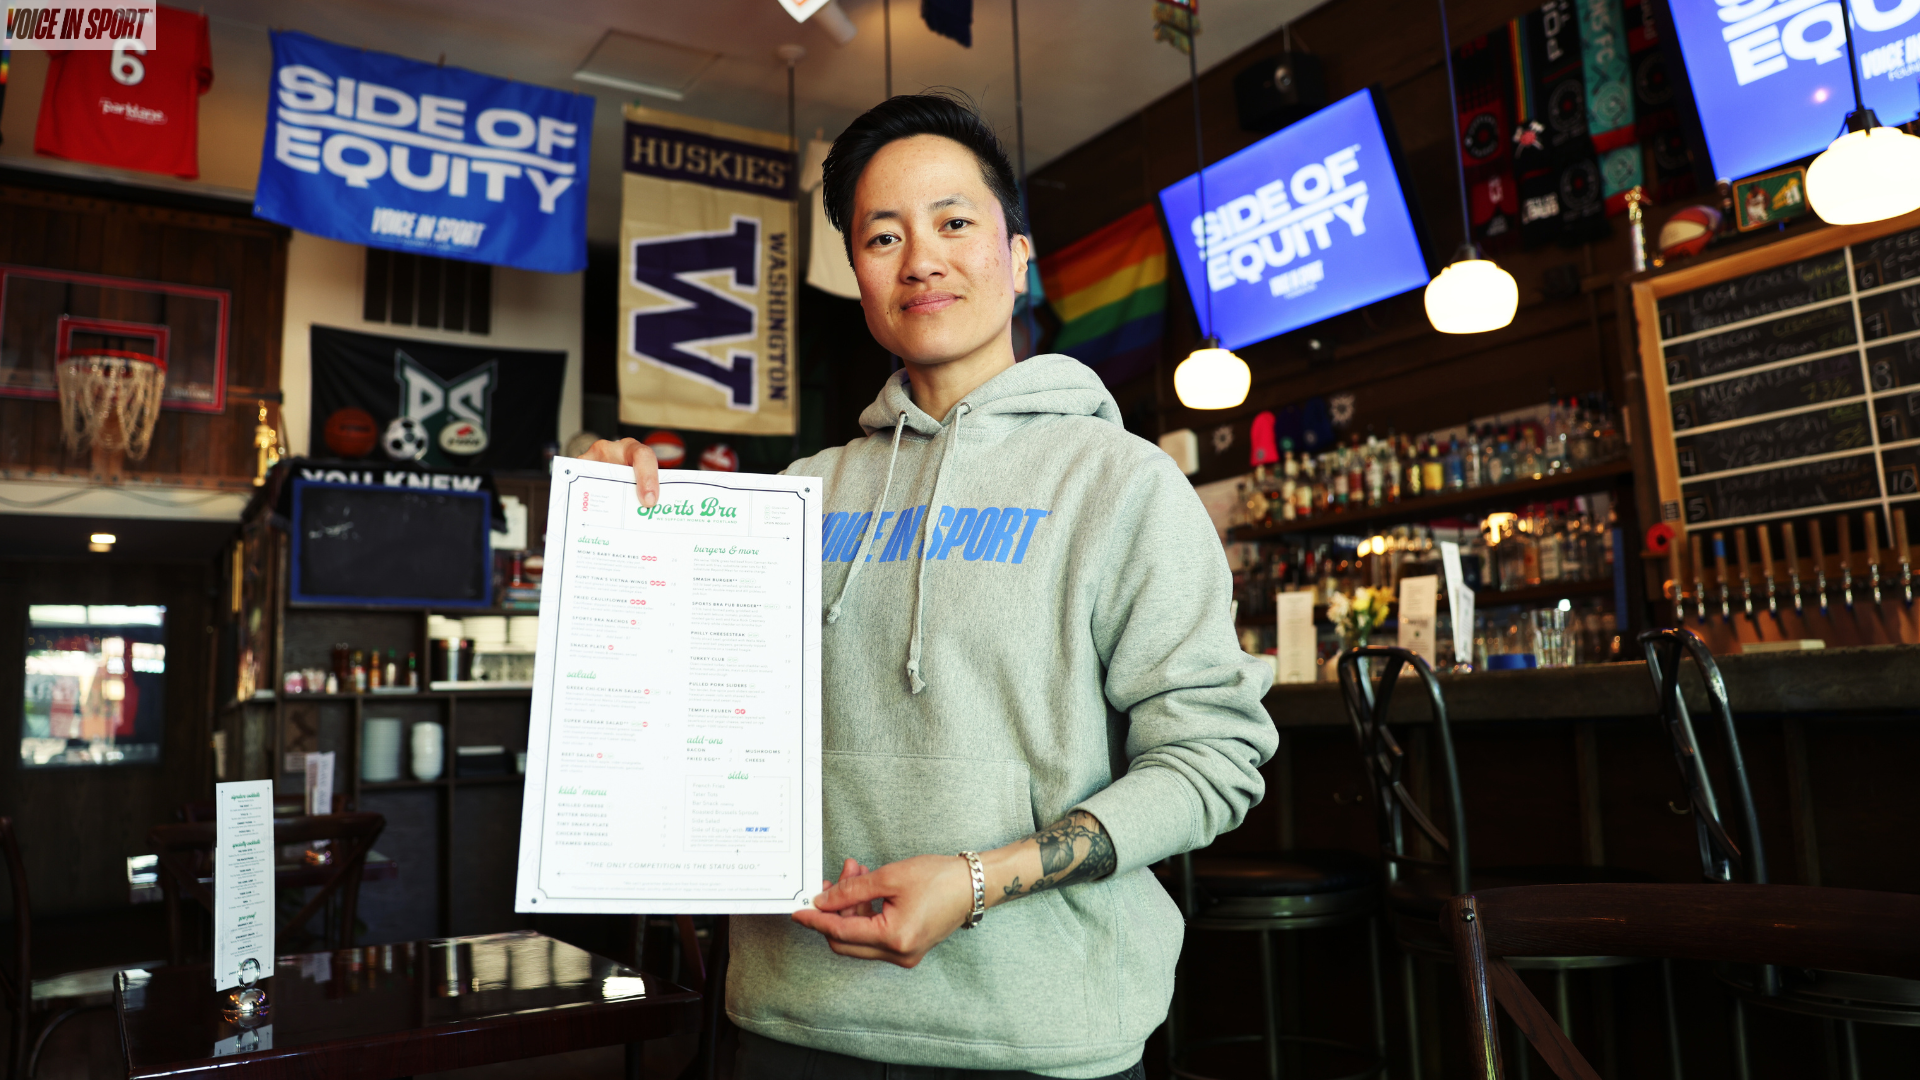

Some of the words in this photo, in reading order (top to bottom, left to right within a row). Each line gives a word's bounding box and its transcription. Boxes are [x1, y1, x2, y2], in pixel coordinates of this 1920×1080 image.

[1860, 39, 1906, 80] VOICE
[277, 64, 466, 142] SIDE
[475, 107, 577, 156] OF
[275, 121, 576, 214] EQUITY
[631, 134, 786, 190] HUSKIES
[1191, 178, 1292, 249] SIDE
[1290, 145, 1360, 205] OF
[1206, 193, 1370, 292] EQUITY
[628, 214, 762, 413] W
[767, 232, 788, 402] WASHINGTON
[1680, 449, 1696, 474] 4
[1892, 470, 1917, 494] 10
[700, 496, 738, 519] Bra
[1687, 497, 1706, 522] 5
[577, 535, 610, 546] starters
[693, 544, 726, 556] burgers
[729, 545, 738, 555] &
[738, 547, 759, 556] more
[822, 510, 895, 562] OICE
[878, 505, 927, 562] IN
[917, 505, 1048, 564] SPORT
[566, 669, 596, 680] salads
[687, 735, 723, 745] add-ons
[728, 770, 749, 780] sides
